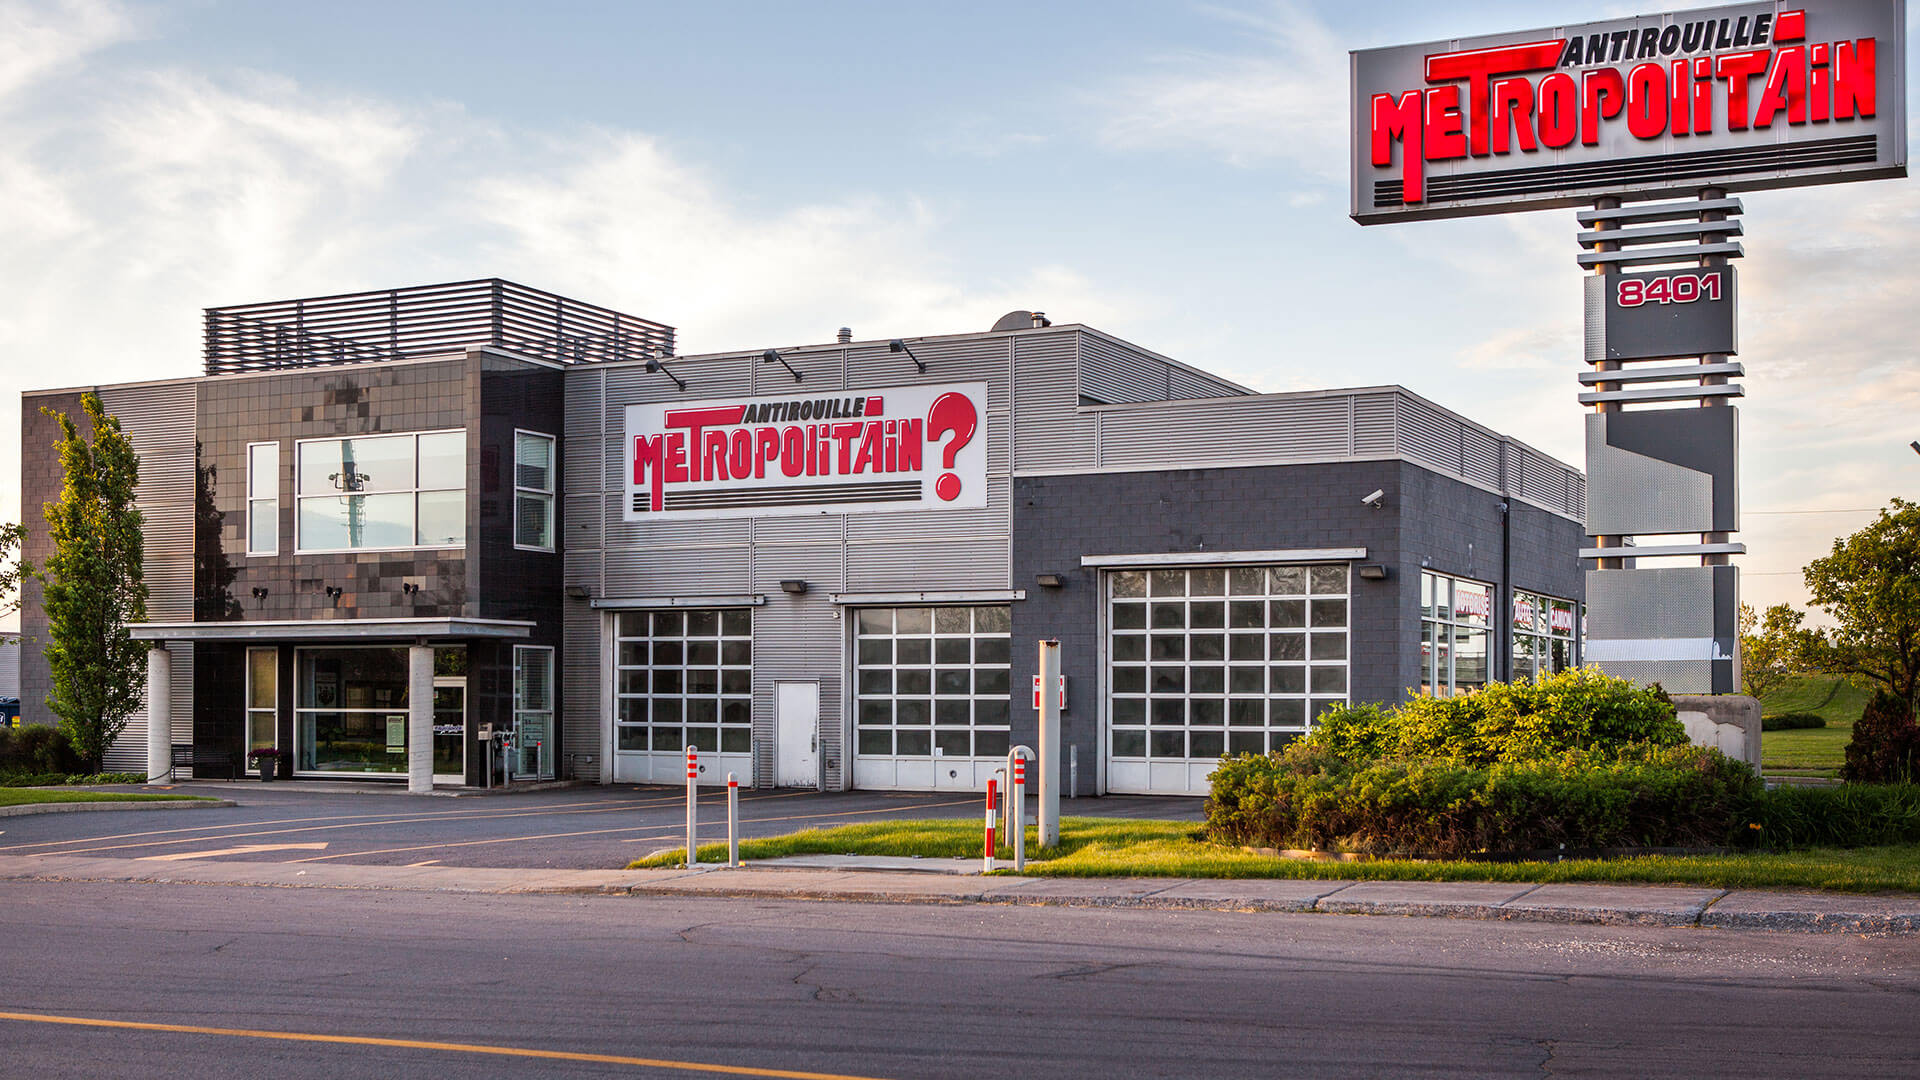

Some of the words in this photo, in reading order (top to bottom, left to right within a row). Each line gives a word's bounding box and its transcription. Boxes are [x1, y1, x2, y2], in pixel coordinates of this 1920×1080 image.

[1561, 12, 1772, 67] ANTIROUILLE
[1617, 272, 1721, 307] 8401
[744, 397, 865, 424] ANTIROUILLE
